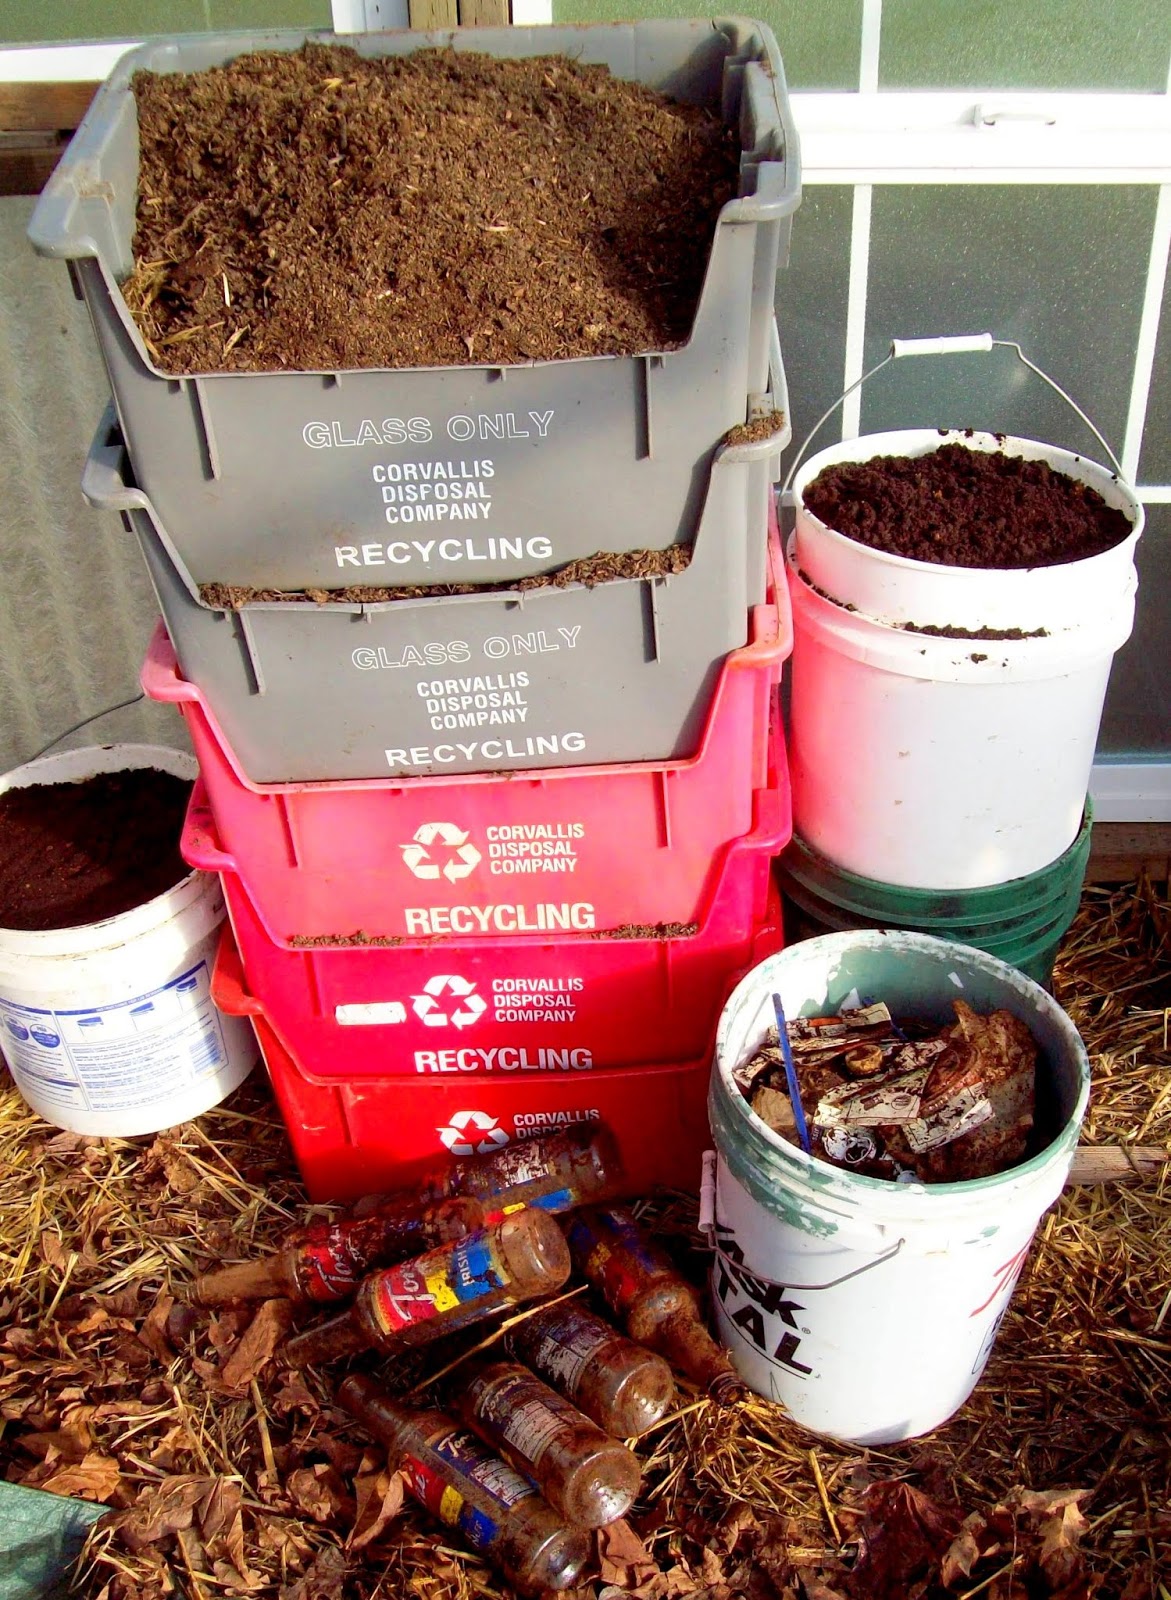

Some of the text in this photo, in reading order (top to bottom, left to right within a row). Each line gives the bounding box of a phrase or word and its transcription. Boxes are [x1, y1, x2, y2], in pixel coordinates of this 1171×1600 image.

[302, 410, 555, 449] GLASS ONLY
[372, 459, 496, 483] CORVALLIS
[381, 481, 492, 504] DISPOSAL
[385, 502, 492, 524] COMPANY
[334, 536, 553, 568] RECYCLING
[351, 625, 582, 671] GLASS ONLY
[416, 671, 530, 698] CORVALLIS
[426, 690, 528, 714] DISPOSAL
[430, 707, 529, 731] COMPANY
[384, 731, 587, 767] RECYCLING
[486, 823, 585, 841] CORVALLIS
[488, 840, 577, 858] DISPOSAL
[490, 857, 578, 875] COMPANY
[404, 902, 596, 935] RECYCLING
[491, 977, 584, 993] CORVALLIS
[493, 994, 577, 1008] DISPOSAL
[494, 1009, 577, 1023] COMPANY
[413, 1047, 594, 1074] RECYCLING
[513, 1108, 600, 1127] CORVALLIS
[515, 1124, 572, 1140] DISPO
[457, 1249, 476, 1287] IRISH
